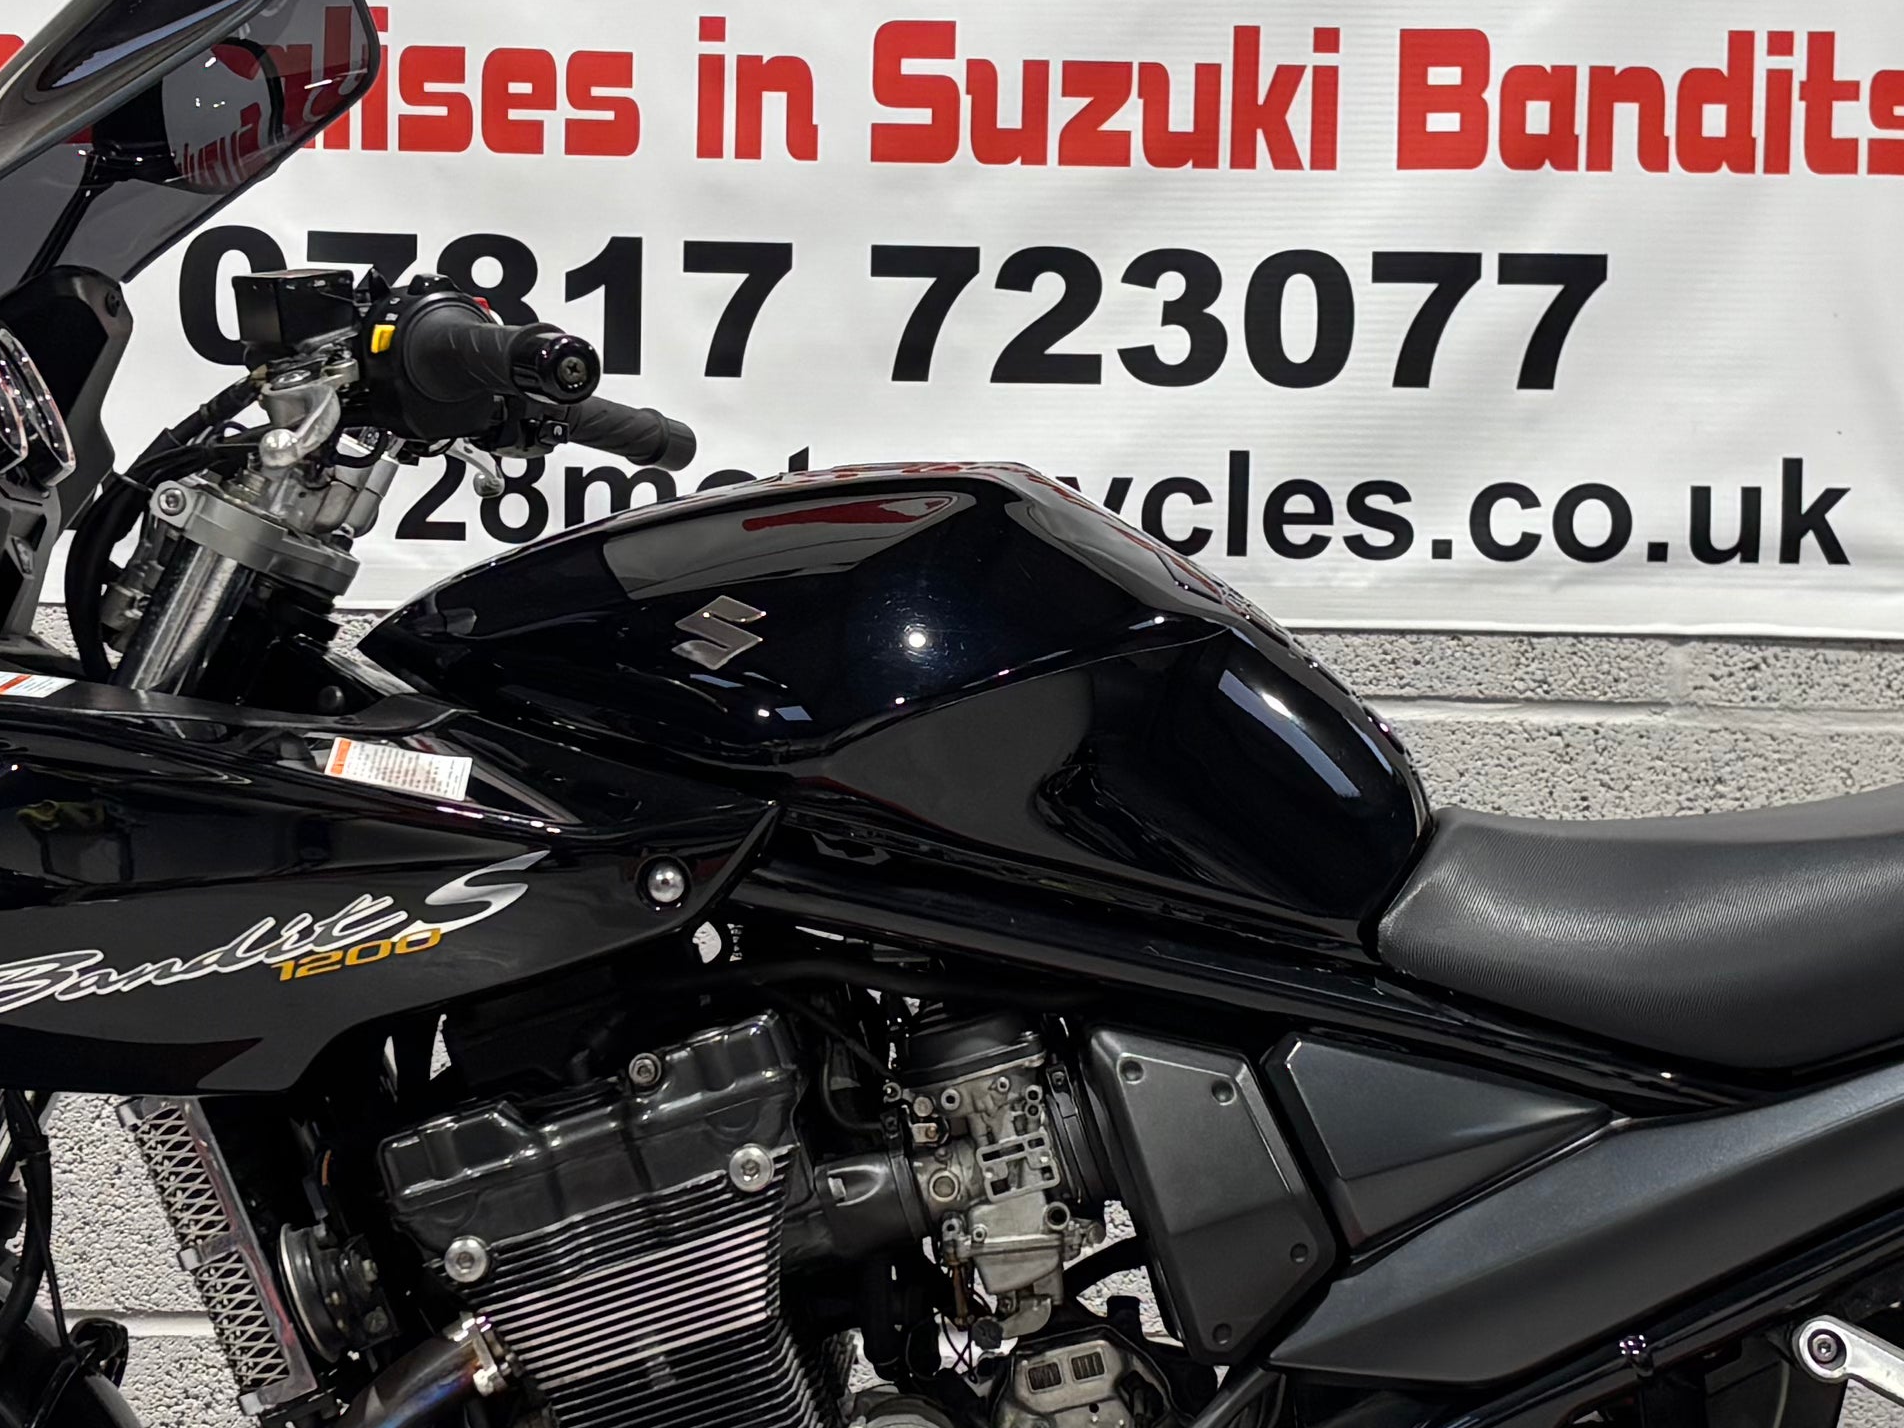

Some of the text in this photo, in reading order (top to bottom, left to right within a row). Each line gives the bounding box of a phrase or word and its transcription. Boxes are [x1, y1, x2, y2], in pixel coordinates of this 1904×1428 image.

[698, 17, 819, 161] in
[872, 21, 1341, 171] Suzuki
[870, 245, 1608, 390] 723077
[390, 850, 550, 941] S
[271, 927, 442, 983] 1200
